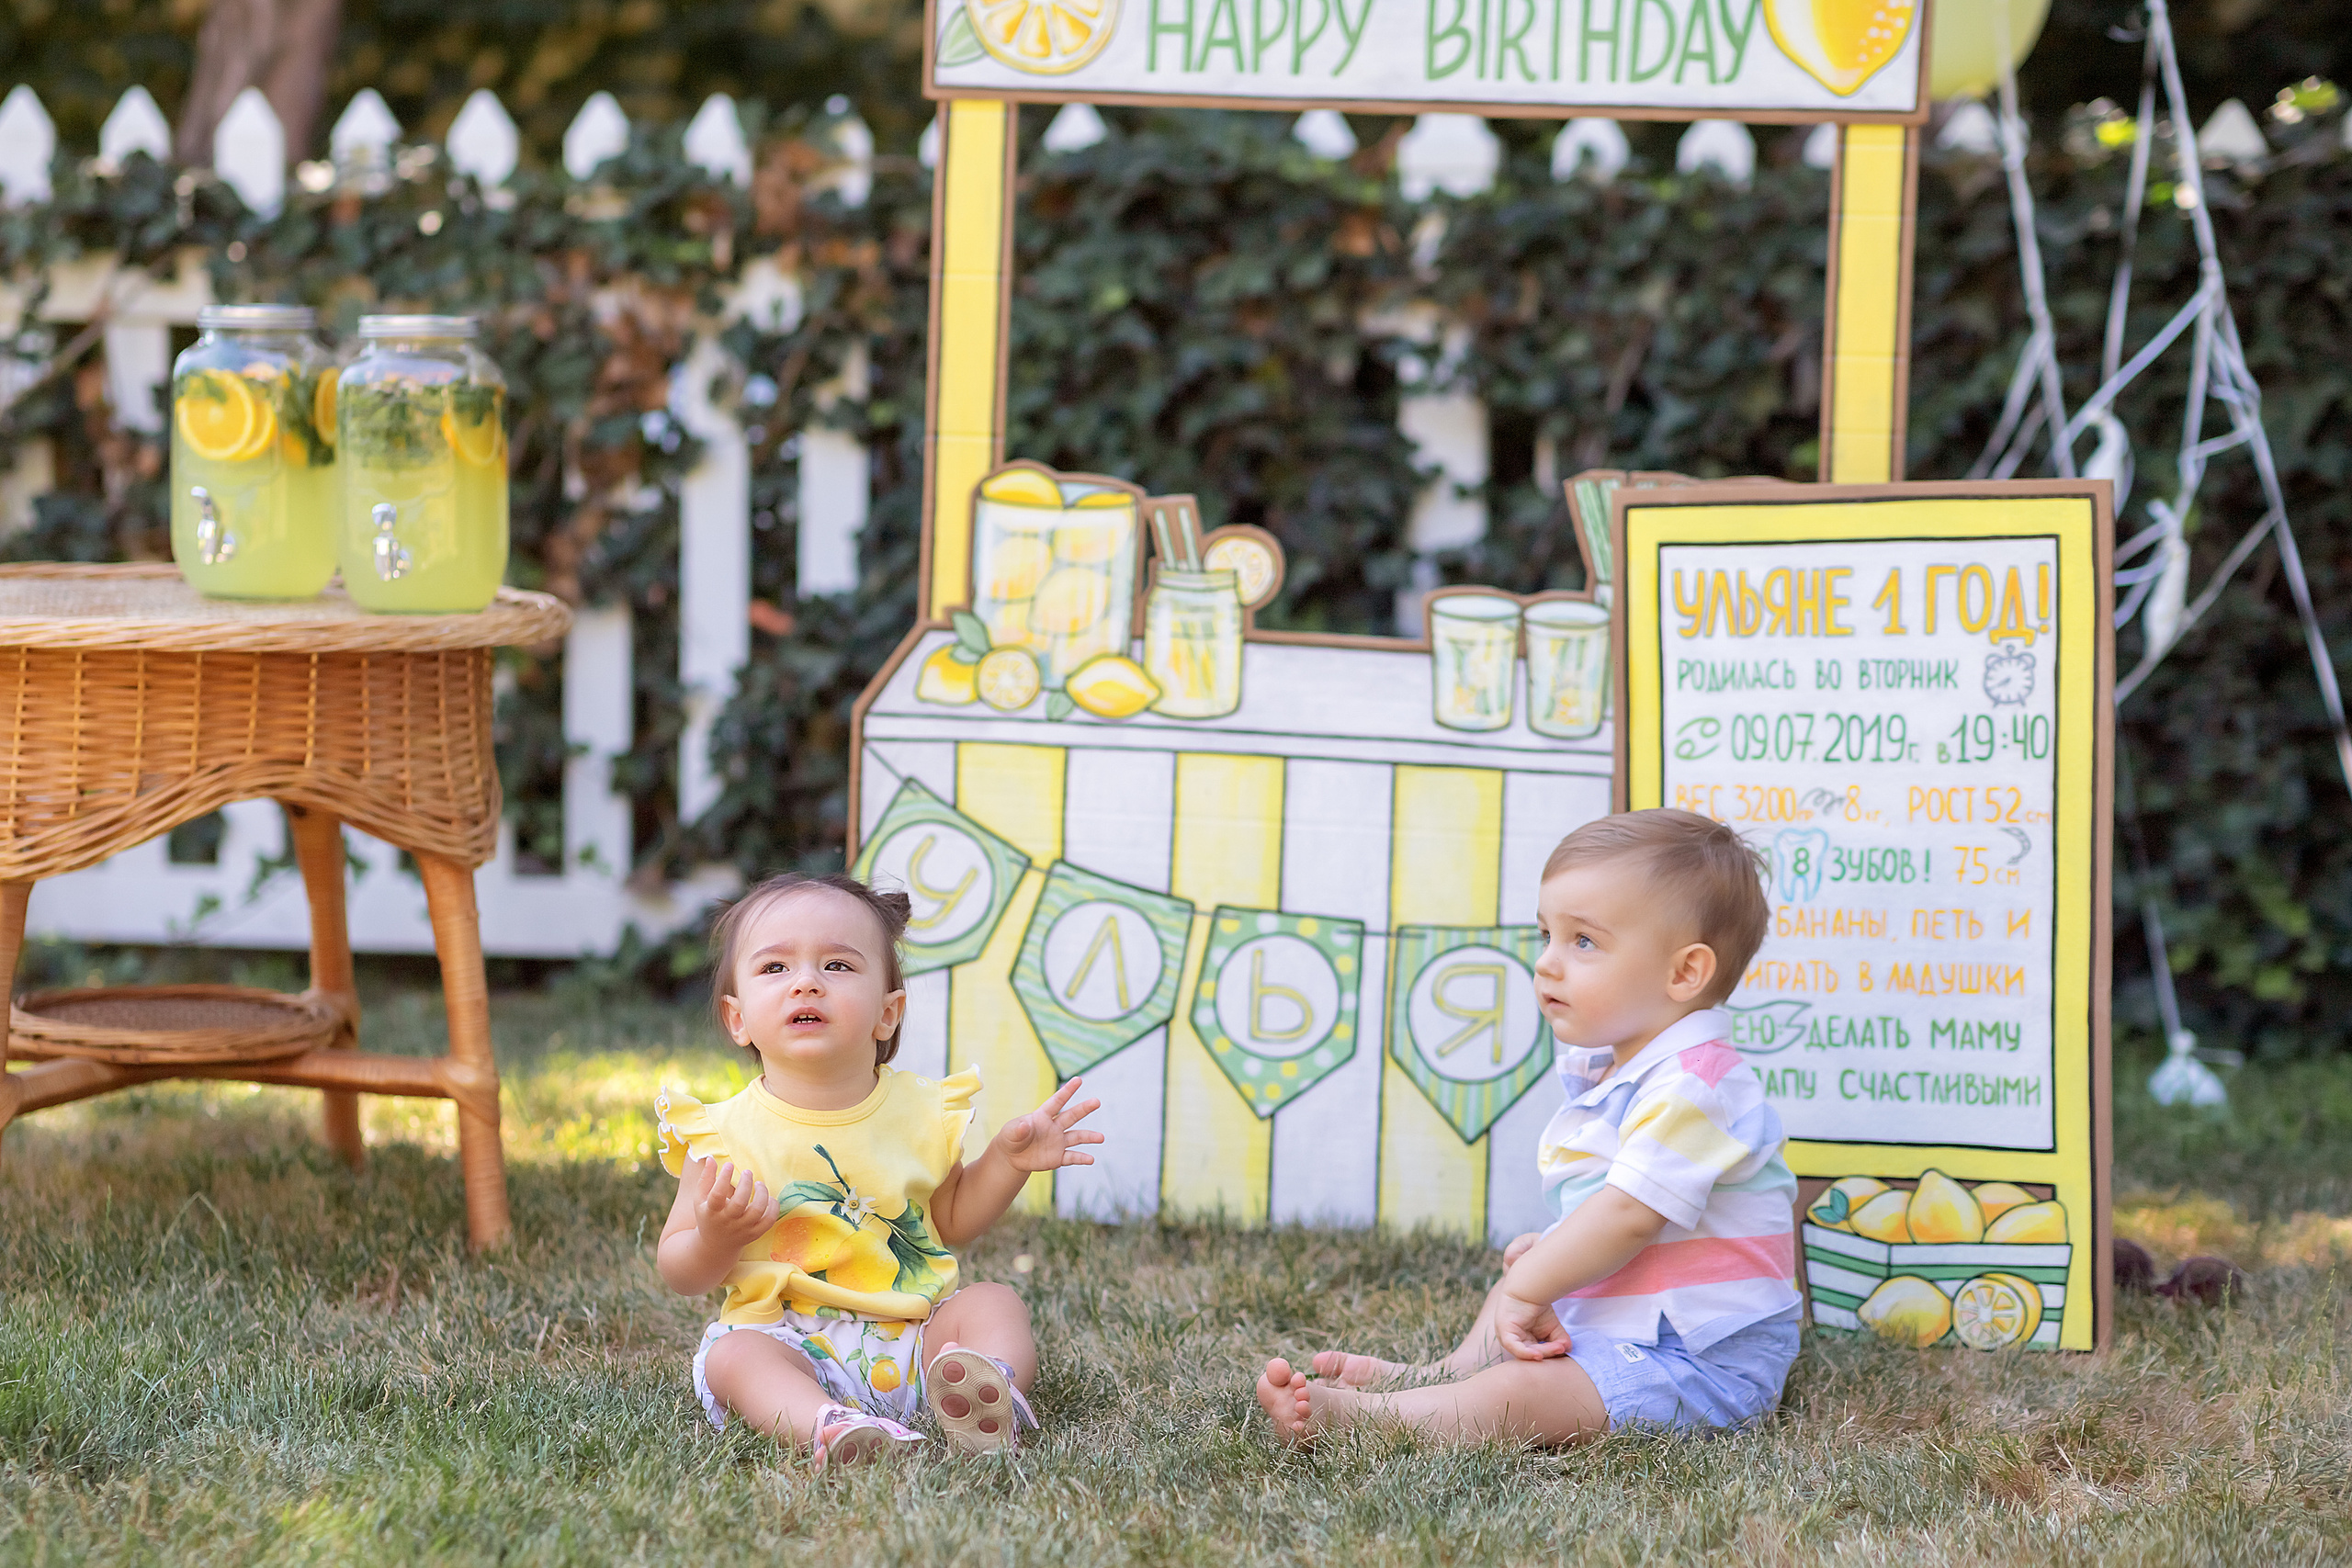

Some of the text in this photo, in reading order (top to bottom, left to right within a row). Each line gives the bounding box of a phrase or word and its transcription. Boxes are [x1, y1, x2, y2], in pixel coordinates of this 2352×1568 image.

[1147, 0, 1757, 85] HAPPY BIRTHDAY
[1673, 563, 2051, 645] УЛЬЯНЕ 1 ГОД!
[1677, 659, 1960, 693] РОДИЛАСЬ ВО ВТОРНИК
[1907, 785, 1975, 823] РОСТ
[1792, 847, 1811, 876] 8
[1912, 908, 1984, 938] ПЕТЬ
[2007, 908, 2032, 938] И
[1858, 960, 1874, 993] В
[1885, 960, 2026, 997] ЛАДУШКИ
[1804, 1015, 1910, 1051] ДЕЛАТЬ
[1929, 1018, 2021, 1052] МАМУ
[1839, 1068, 2041, 1106] СЧАСТЛИВЫМИ
